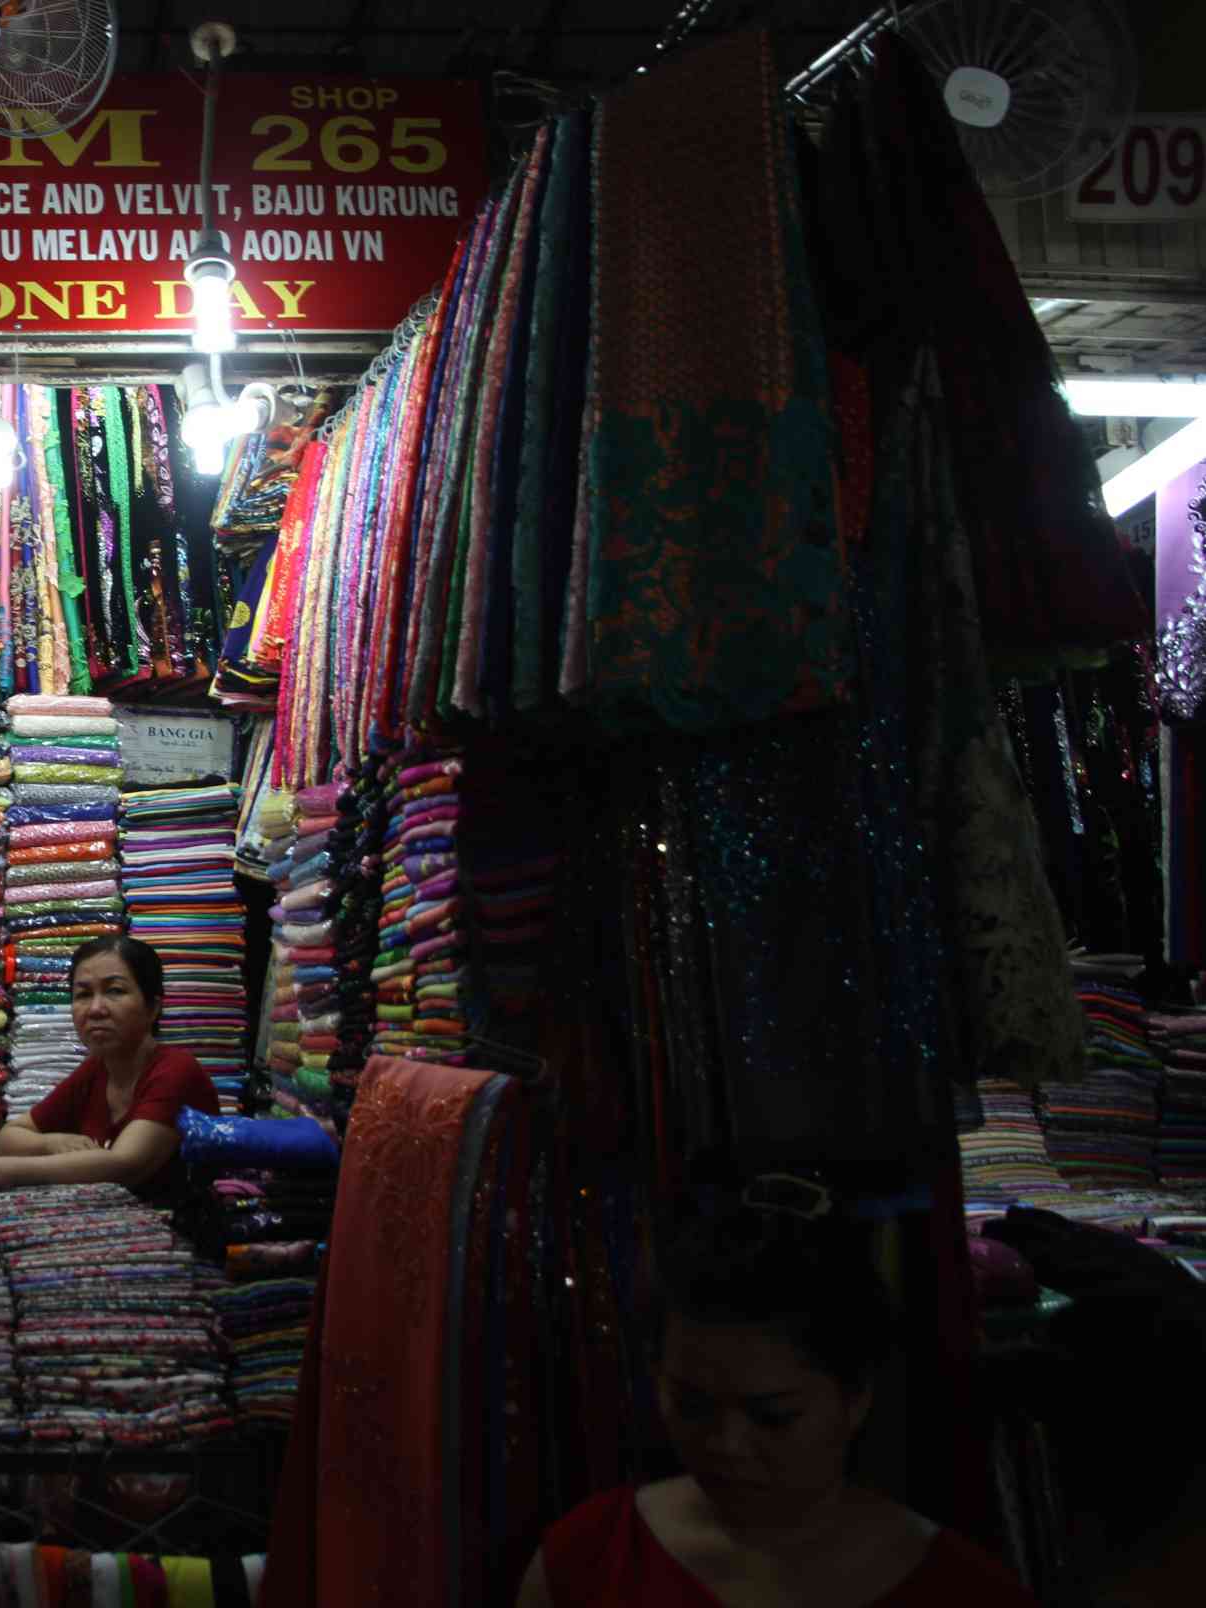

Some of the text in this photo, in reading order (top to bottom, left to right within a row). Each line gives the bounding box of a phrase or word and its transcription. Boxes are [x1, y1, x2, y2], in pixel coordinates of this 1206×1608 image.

[291, 86, 399, 110] SHOP
[250, 115, 448, 173] 265
[41, 183, 104, 216] AND
[252, 184, 326, 216] BAJU
[336, 185, 458, 217] KURUNG
[32, 229, 158, 262] MELAYU
[242, 230, 333, 262] AODAI
[342, 231, 384, 262] VN
[154, 280, 316, 320] DAY
